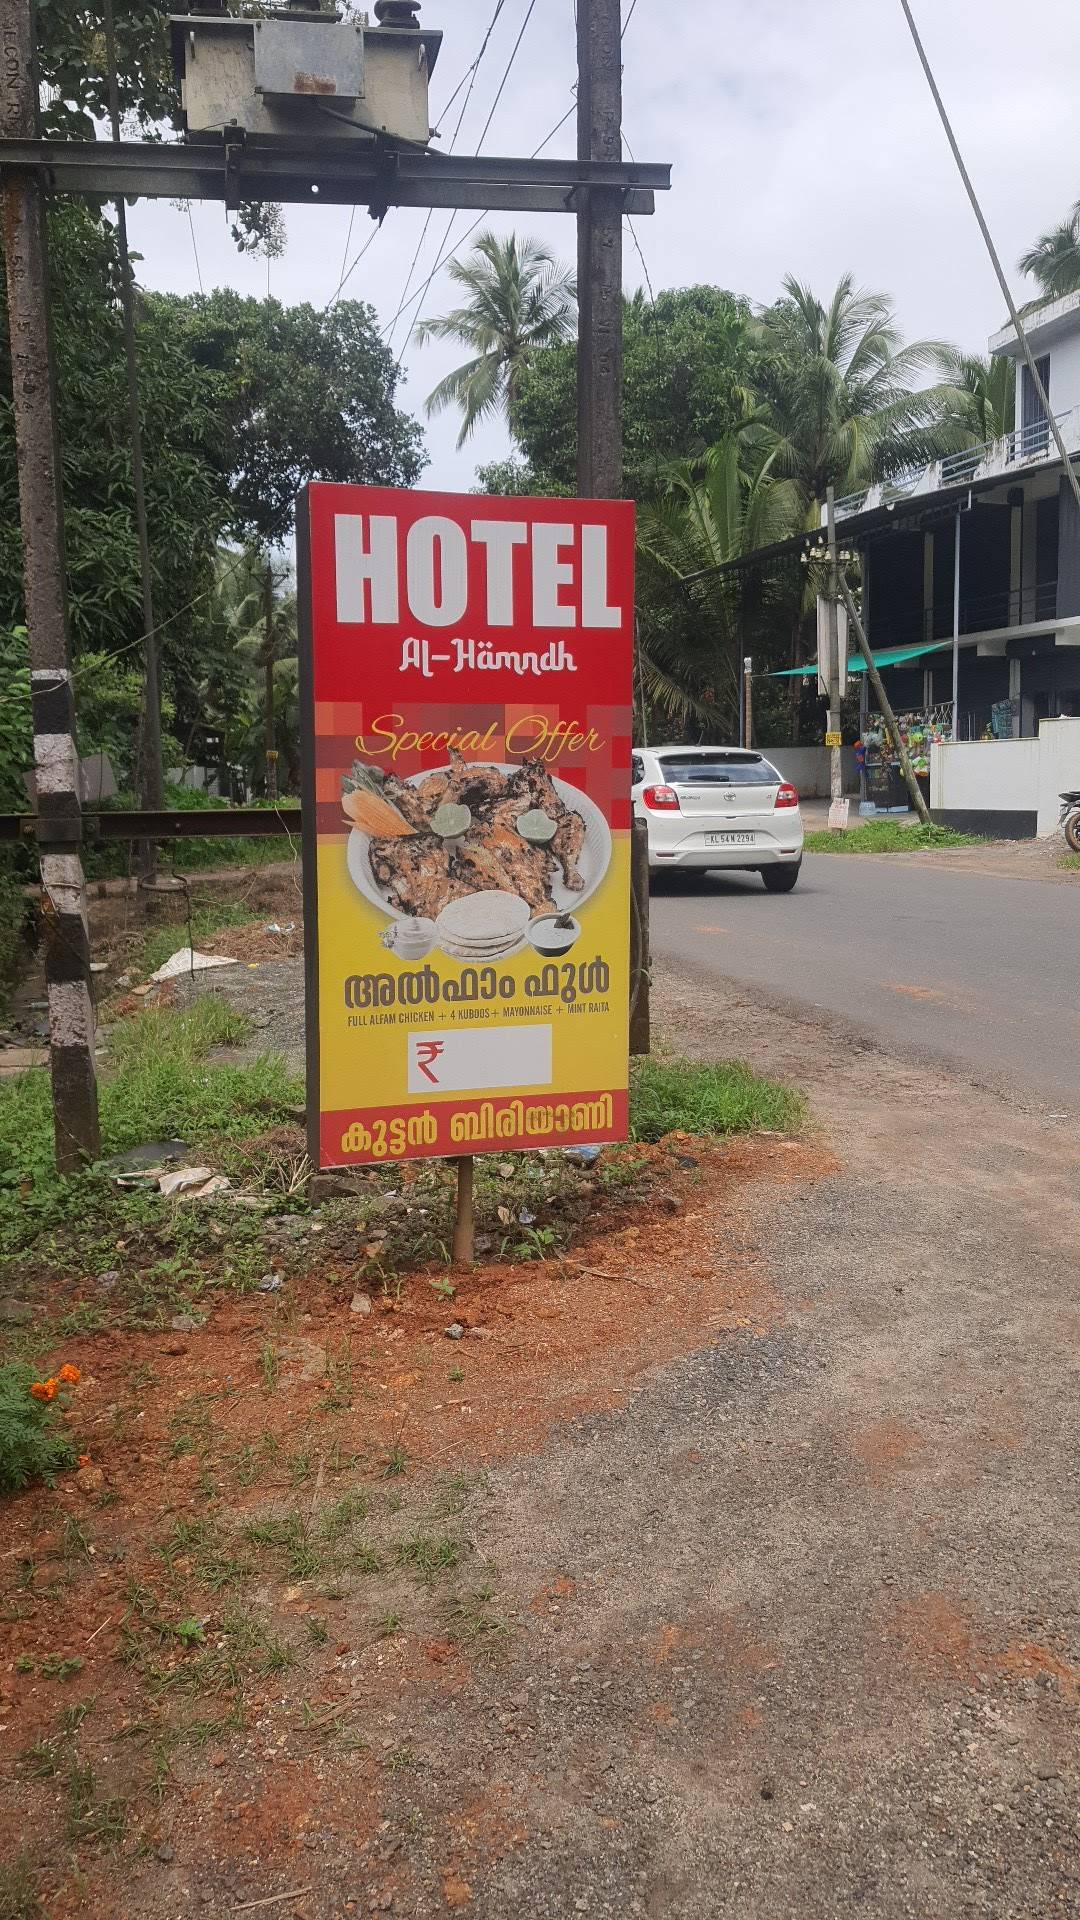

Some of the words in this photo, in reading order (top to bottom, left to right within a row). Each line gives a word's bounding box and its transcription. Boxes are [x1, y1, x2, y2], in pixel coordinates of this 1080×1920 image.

[334, 514, 622, 628] HOTEL
[355, 713, 499, 761] Special
[505, 714, 606, 762] Offer
[344, 964, 516, 1008] അൽഫാം
[524, 955, 610, 1003] ഫുൾ
[348, 1015, 368, 1027] FULL
[369, 1013, 396, 1026] ALFAM
[398, 1011, 435, 1024] CHICKEN
[450, 1010, 456, 1020] 4
[502, 1004, 553, 1017] MAYONNAISE
[567, 1002, 586, 1014] MINT
[588, 1001, 610, 1013] RAITA
[415, 1040, 445, 1084] ₹
[341, 1109, 438, 1157] കുട്ടൻ
[450, 1093, 613, 1142] ബിരിയാണി
